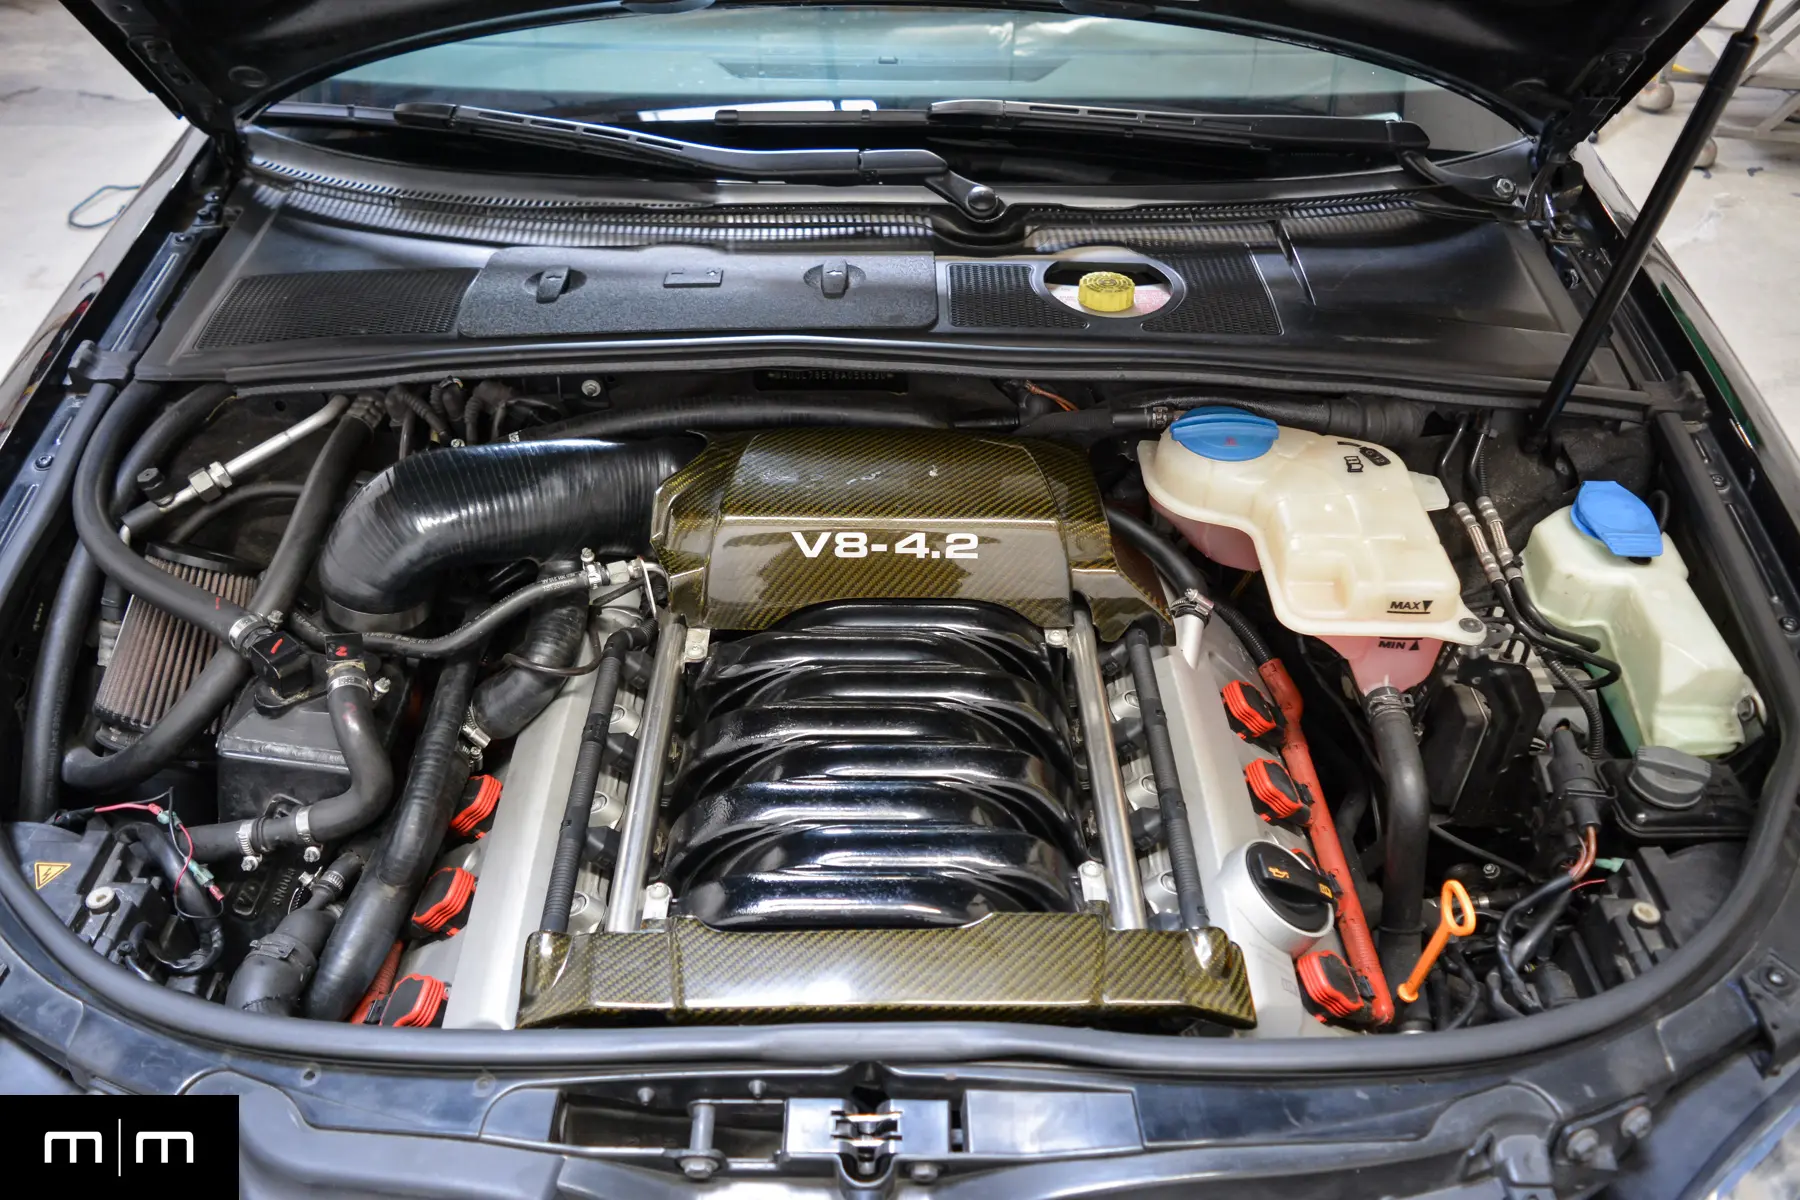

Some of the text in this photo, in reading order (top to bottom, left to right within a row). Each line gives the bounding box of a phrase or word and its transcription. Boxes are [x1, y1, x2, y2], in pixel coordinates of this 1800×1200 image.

[791, 532, 979, 559] V8-4.2
[1389, 601, 1422, 610] MAX
[1378, 640, 1406, 650] MIN
